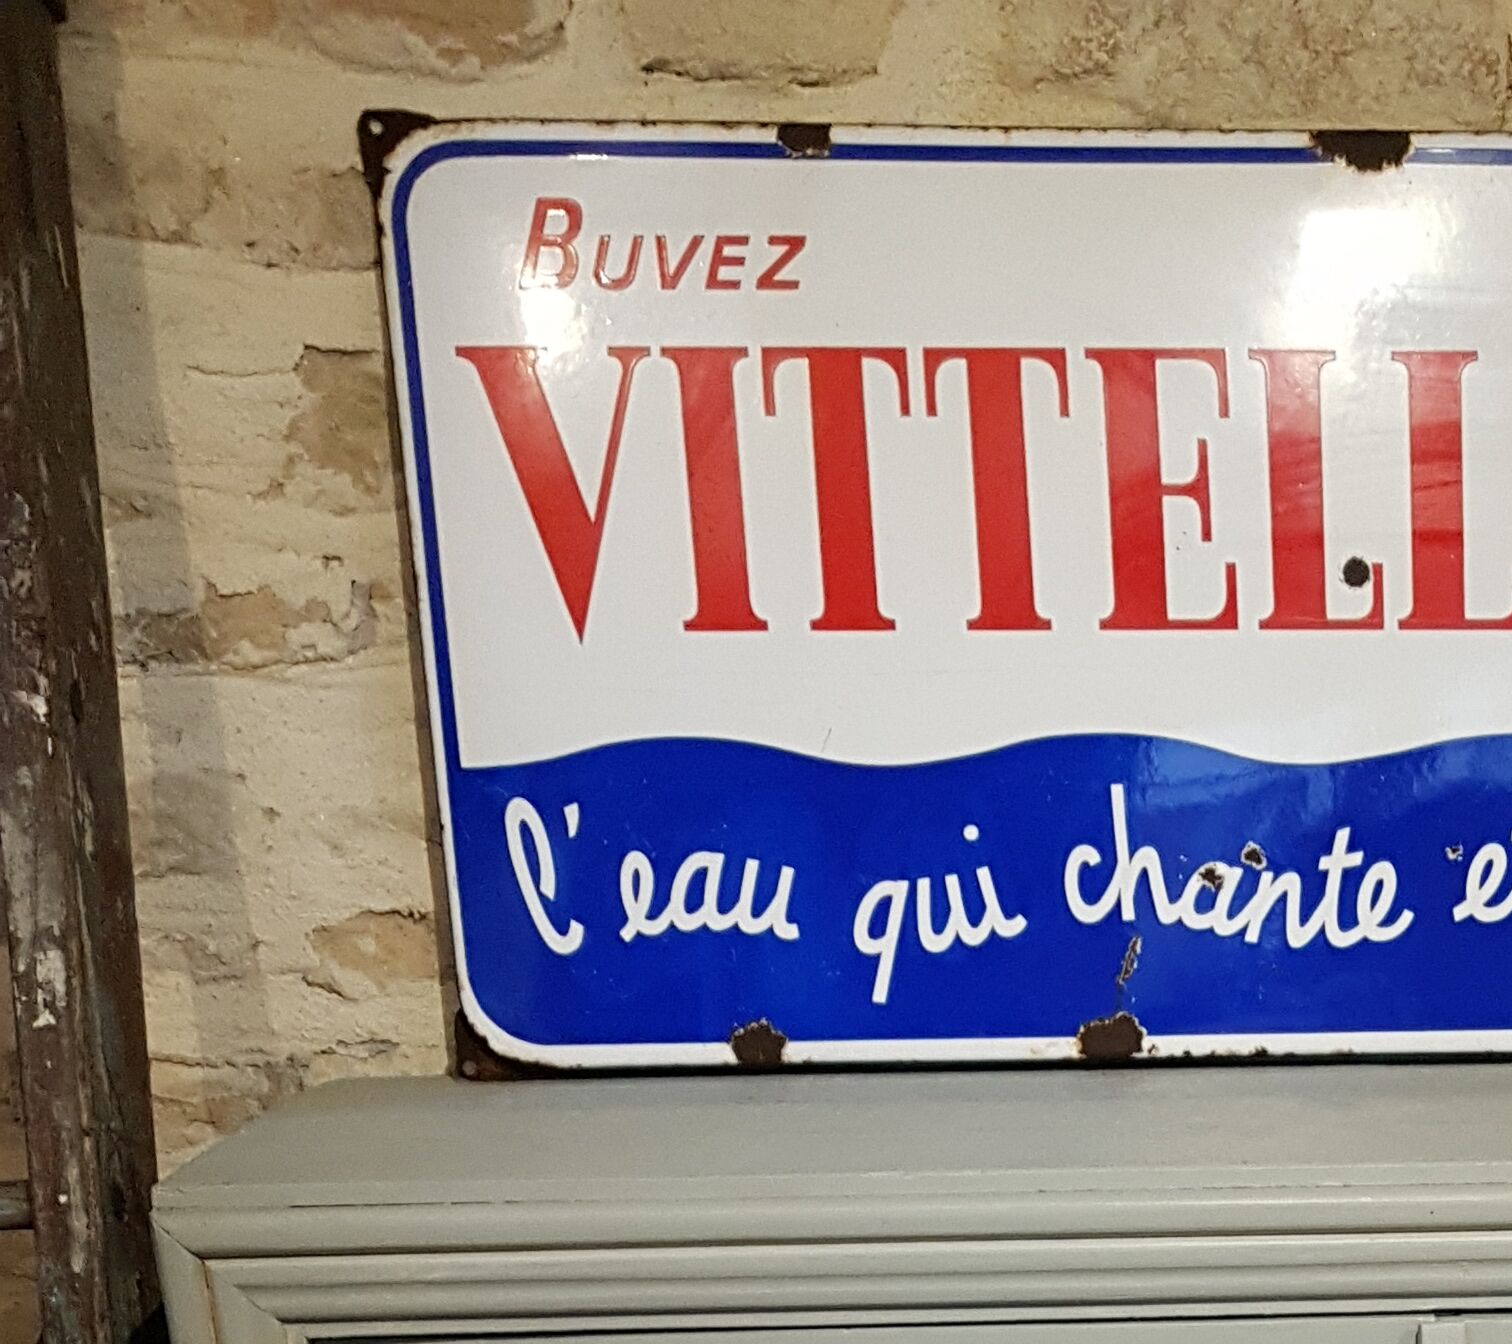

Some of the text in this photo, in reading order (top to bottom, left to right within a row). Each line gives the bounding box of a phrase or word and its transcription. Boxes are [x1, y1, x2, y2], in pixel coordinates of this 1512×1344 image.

[518, 196, 808, 292] BUVEZ
[504, 796, 801, 956] l'eau
[853, 823, 1027, 1004] qui
[1063, 783, 1415, 950] chante
